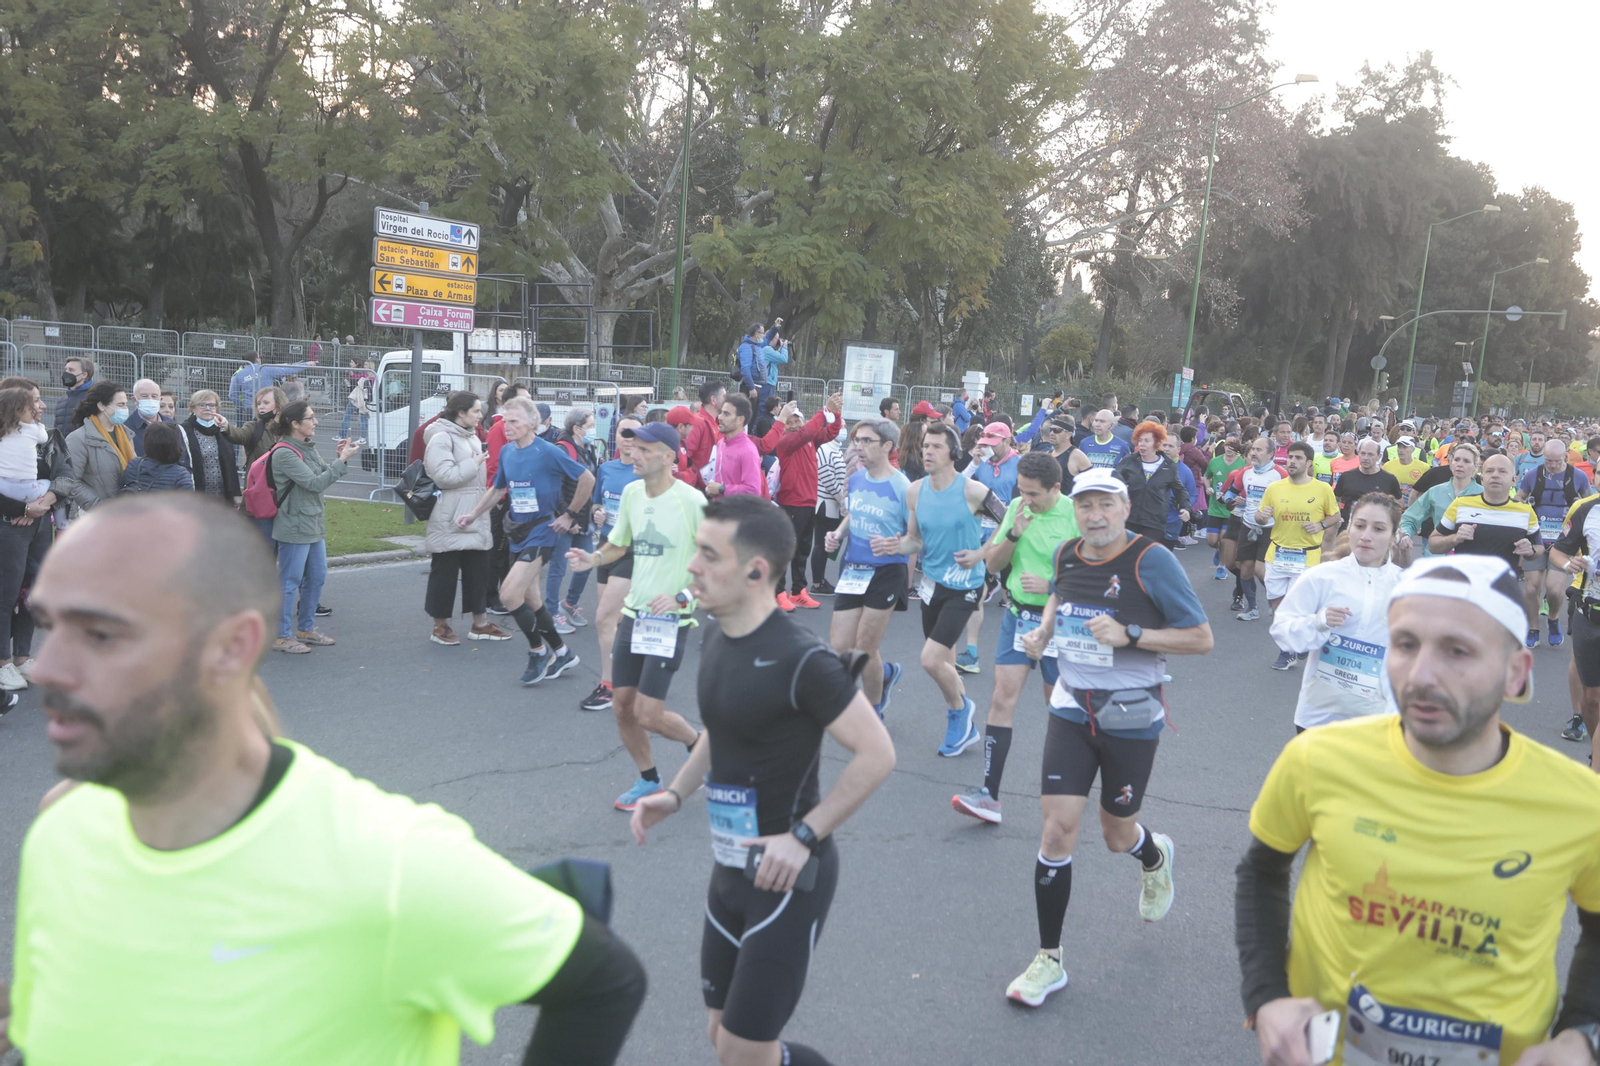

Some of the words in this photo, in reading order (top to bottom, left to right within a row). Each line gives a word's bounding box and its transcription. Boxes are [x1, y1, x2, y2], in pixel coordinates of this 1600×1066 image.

[381, 212, 408, 224] hospital
[381, 222, 408, 234] Virgen
[411, 227, 424, 236] del
[427, 229, 449, 240] Rocío
[380, 245, 408, 255] estación
[412, 247, 434, 258] Prado
[380, 253, 396, 263] San
[400, 256, 440, 269] Sebastián
[447, 282, 473, 290] estación
[406, 286, 428, 297] Plaza
[433, 290, 443, 298] de
[447, 290, 472, 301] Armas
[420, 306, 443, 317] Caixa
[446, 308, 471, 320] Forum
[418, 316, 440, 326] Torre
[443, 318, 470, 330] Sevilla
[558, 392, 569, 400] AMS
[860, 516, 882, 534] Tres
[1073, 607, 1106, 617] ZURICH
[1066, 640, 1082, 649] JOSÉ
[1084, 642, 1098, 651] LUIS
[1342, 639, 1378, 656] ZURICH
[1336, 656, 1362, 670] 10704
[1334, 668, 1358, 682] GRECIA
[707, 787, 747, 804] URICH
[1400, 893, 1501, 932] MARATON
[1388, 1012, 1482, 1041] ZURICH
[1388, 1048, 1441, 1066] 9047
